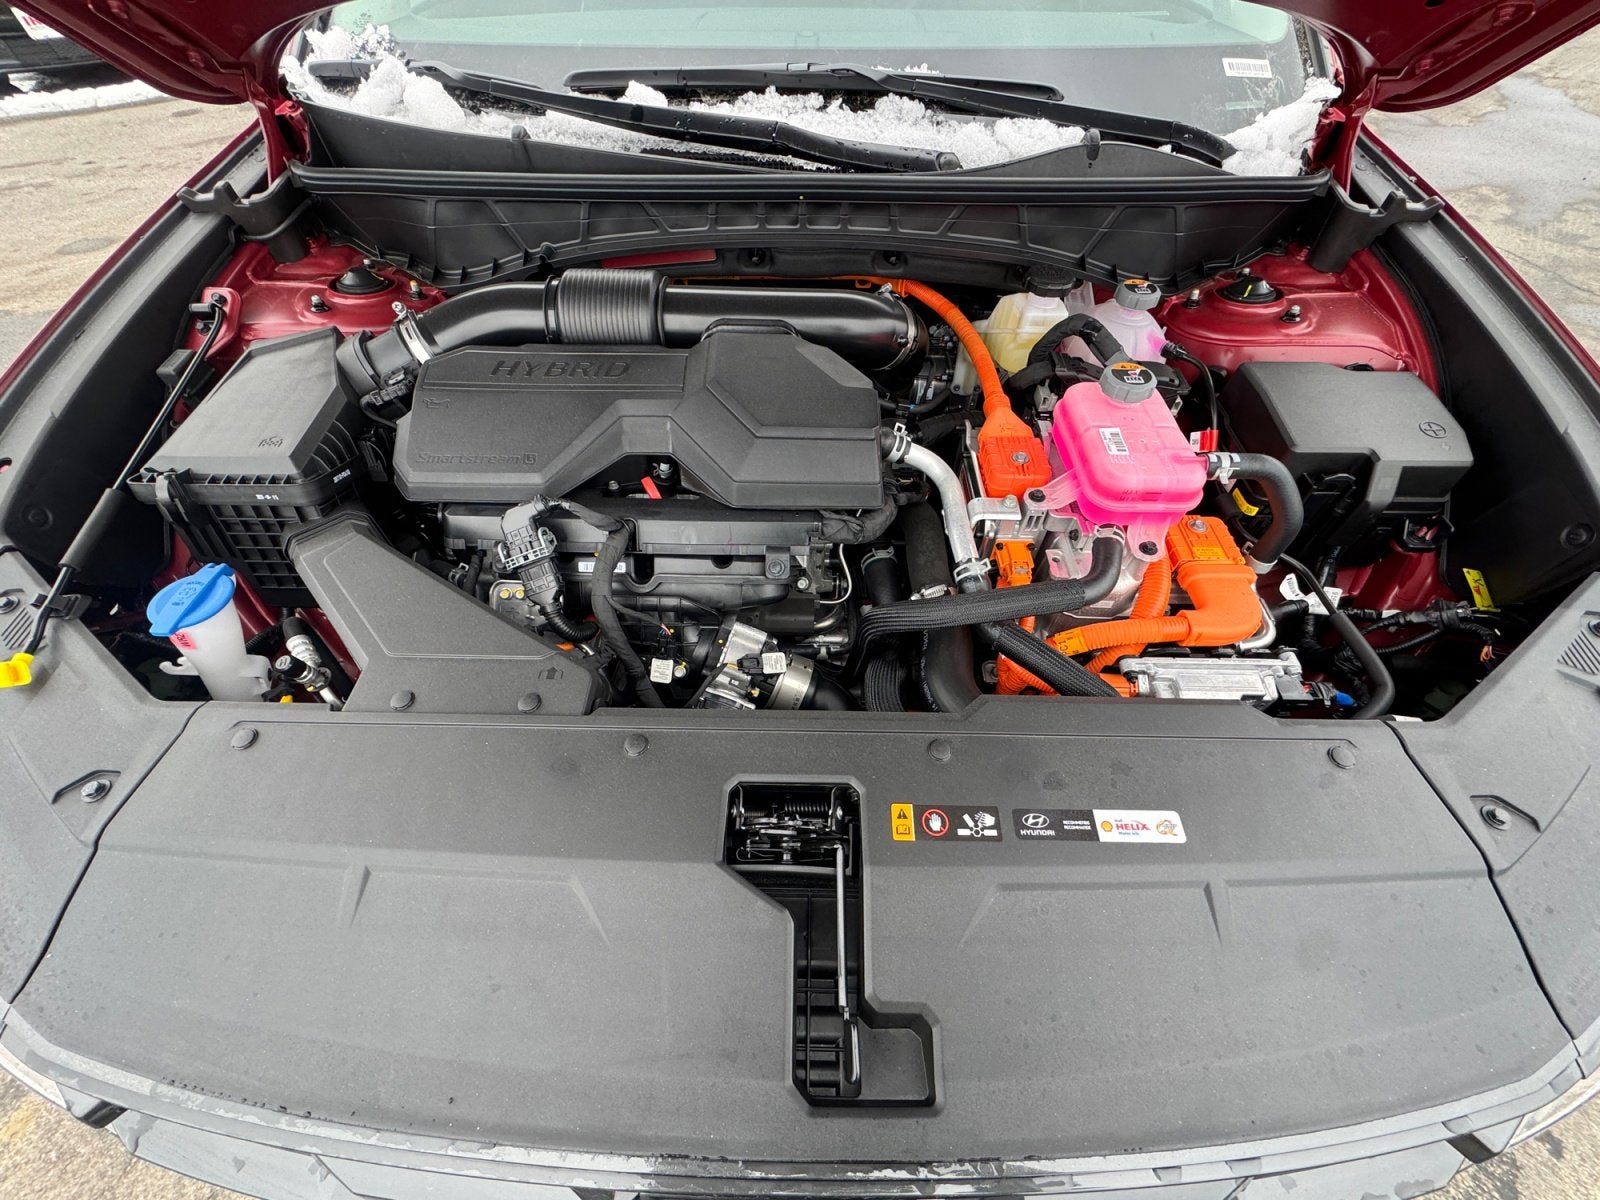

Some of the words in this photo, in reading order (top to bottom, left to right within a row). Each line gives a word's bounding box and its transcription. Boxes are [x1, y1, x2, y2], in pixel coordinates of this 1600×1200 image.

[489, 360, 630, 379] HYBRID
[416, 452, 521, 464] Smartstream
[1115, 822, 1152, 832] HELIX
